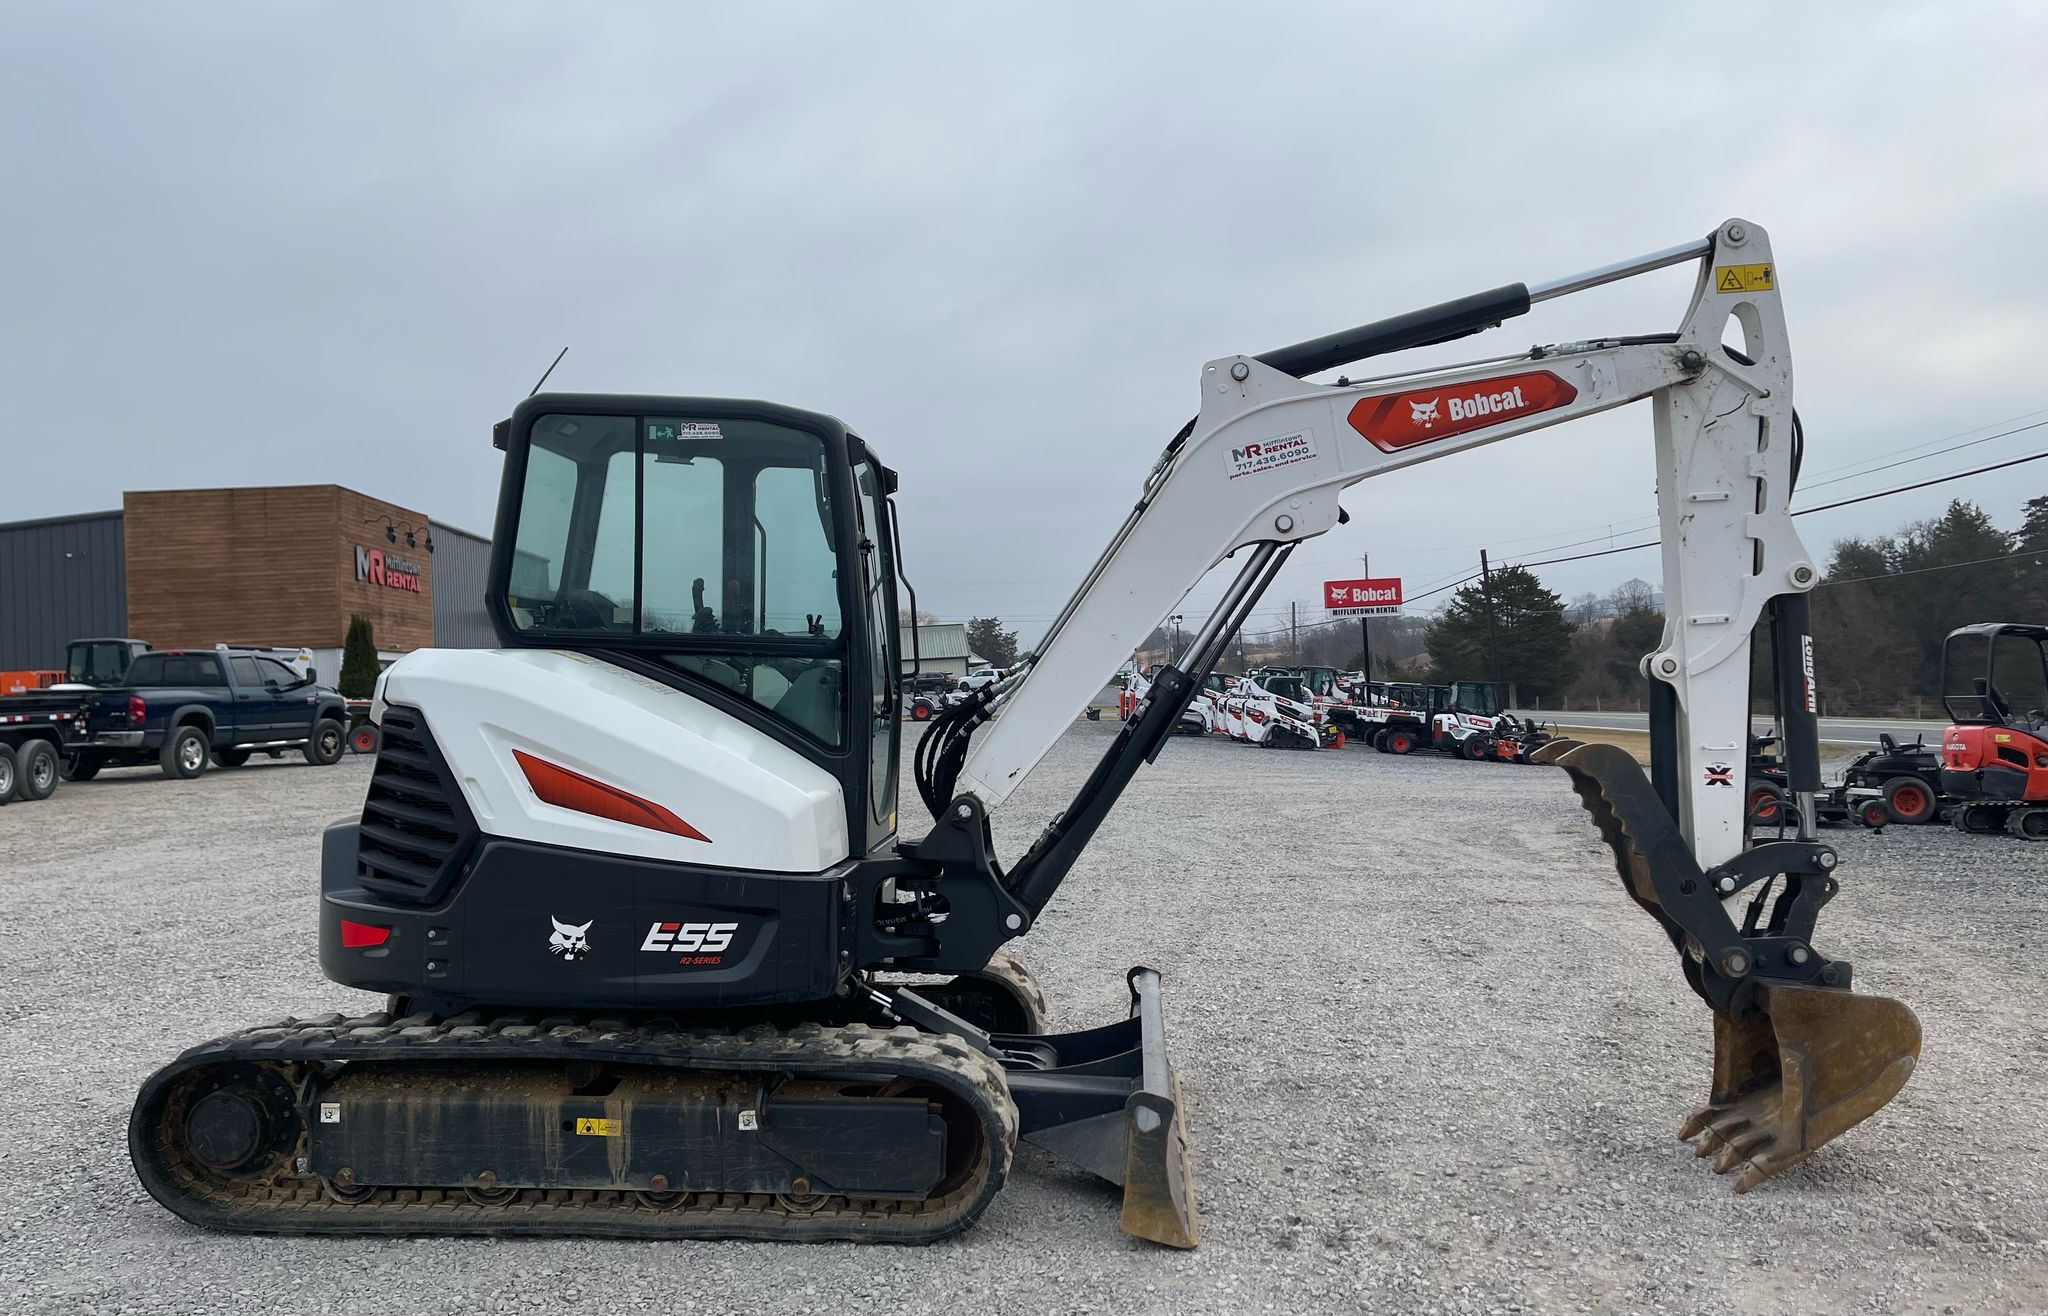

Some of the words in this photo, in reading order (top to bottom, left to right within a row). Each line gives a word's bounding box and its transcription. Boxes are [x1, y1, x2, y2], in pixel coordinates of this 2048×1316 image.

[1448, 386, 1525, 421] Bobcat
[1263, 434, 1303, 448] Mifflintown
[1264, 439, 1308, 455] RENTAL
[1231, 444, 1263, 462] MR
[1236, 447, 1309, 471] 717.436.6090
[1229, 471, 1253, 480] parts,
[1252, 465, 1275, 473] sales,
[1274, 460, 1289, 468] and
[1289, 453, 1317, 463] service
[355, 545, 385, 585] MR
[385, 571, 422, 592] RENTAL
[1352, 587, 1397, 602] Bobcat
[1332, 608, 1375, 616] MIFFLINTOWN
[1375, 606, 1398, 614] RENTAL
[1802, 634, 1817, 713] LongArm
[640, 922, 739, 952] E55
[680, 956, 722, 965] R2-SERIES
